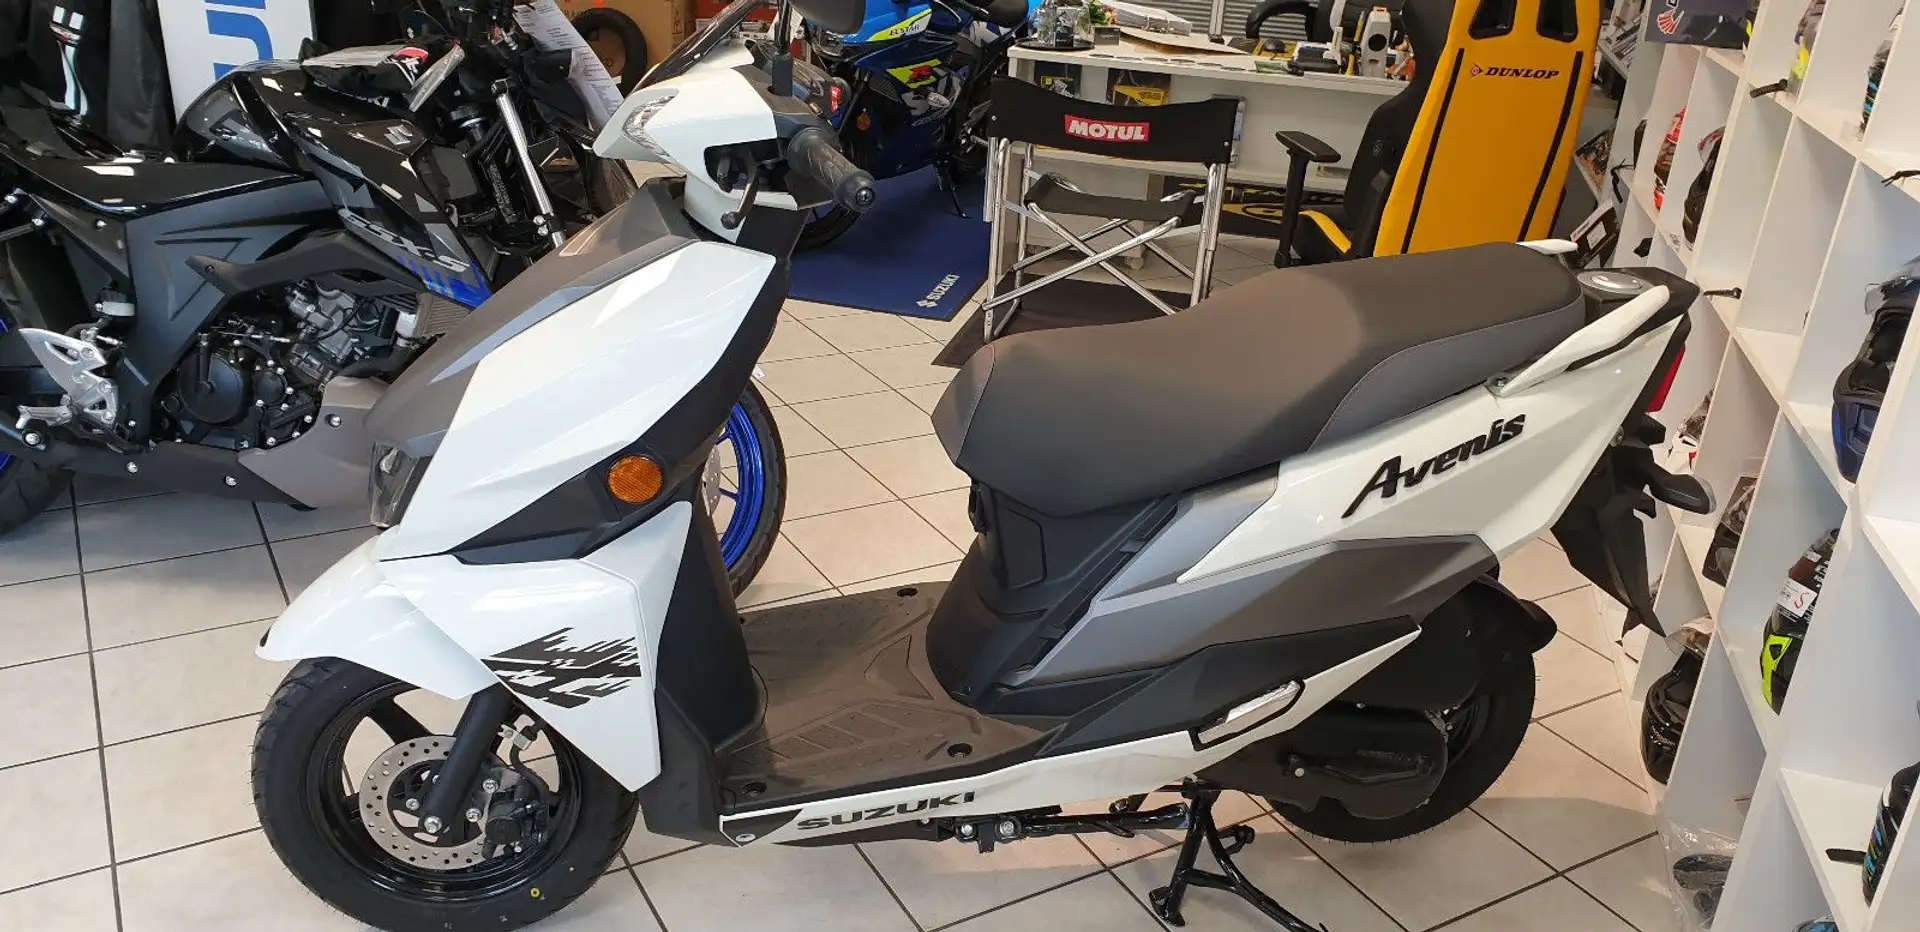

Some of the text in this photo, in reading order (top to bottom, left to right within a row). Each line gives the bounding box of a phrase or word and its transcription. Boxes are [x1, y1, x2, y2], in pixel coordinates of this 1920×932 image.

[889, 24, 920, 36] ECSTAR
[1485, 67, 1559, 79] DUNLOP
[1068, 120, 1145, 140] MOTUL
[338, 208, 470, 273] GSX-S
[926, 274, 960, 301] SUZUKI
[1341, 414, 1526, 519] Avenis
[797, 791, 976, 830] SUZUKI
